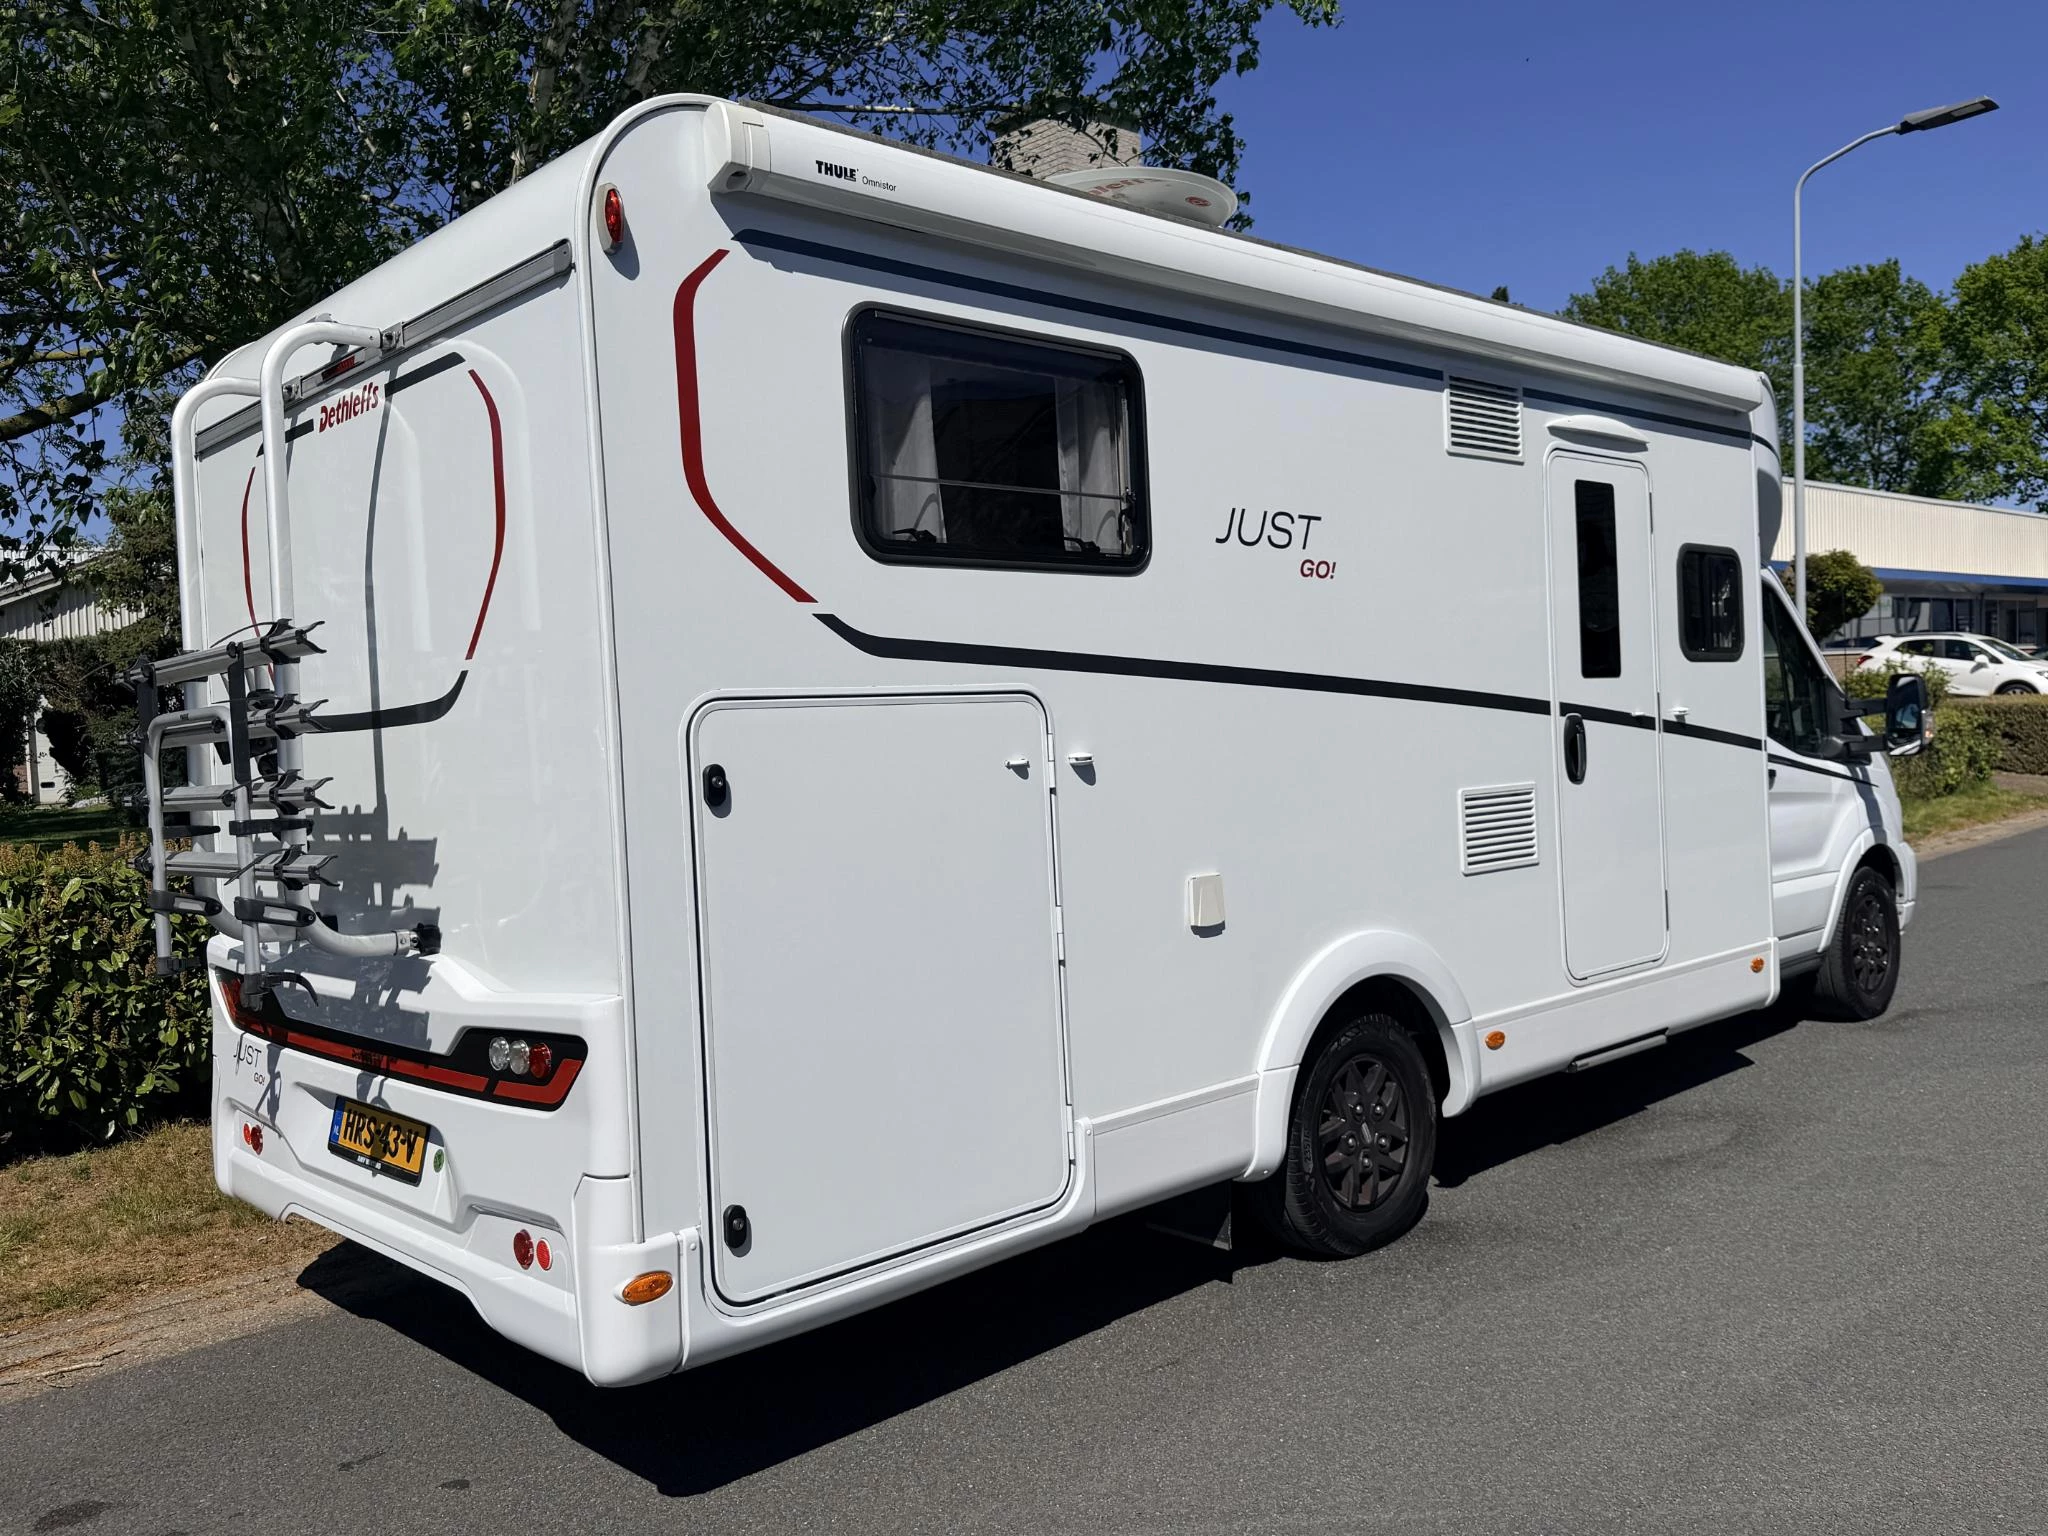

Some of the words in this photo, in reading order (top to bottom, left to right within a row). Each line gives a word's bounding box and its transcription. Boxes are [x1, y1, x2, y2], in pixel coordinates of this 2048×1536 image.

[815, 160, 857, 182] THULE
[861, 175, 897, 192] Omnistor
[318, 381, 379, 433] Dethleffs
[1215, 507, 1322, 550] JUST
[1300, 558, 1337, 580] GO!
[233, 1041, 262, 1068] JUST
[253, 1072, 266, 1086] GO!
[343, 1107, 419, 1164] HRS-43-V
